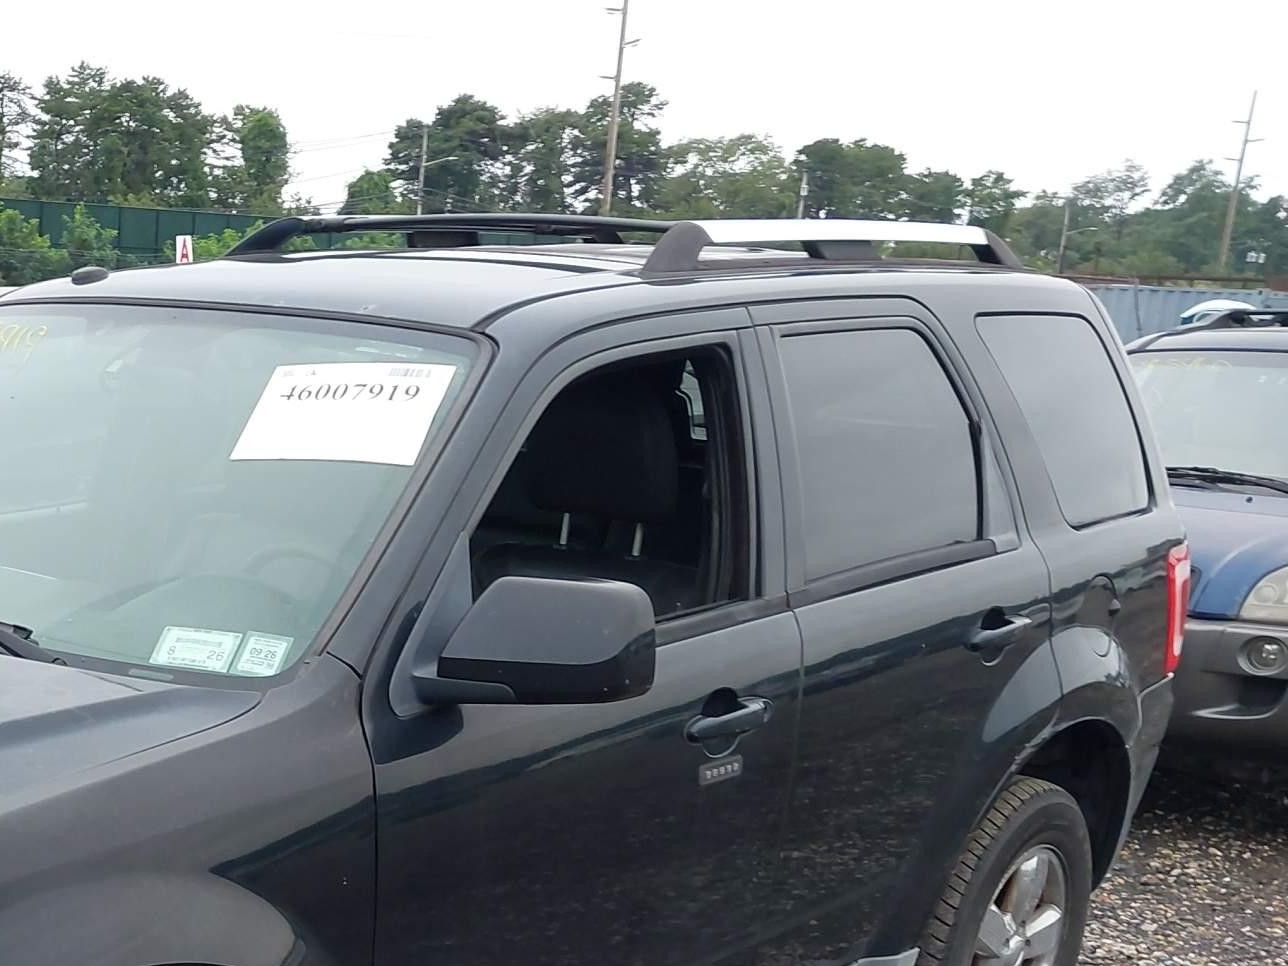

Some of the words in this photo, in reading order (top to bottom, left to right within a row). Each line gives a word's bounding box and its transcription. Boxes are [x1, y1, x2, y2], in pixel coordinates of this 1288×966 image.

[180, 237, 190, 262] A
[280, 383, 421, 401] 46007919
[206, 649, 225, 662] 26
